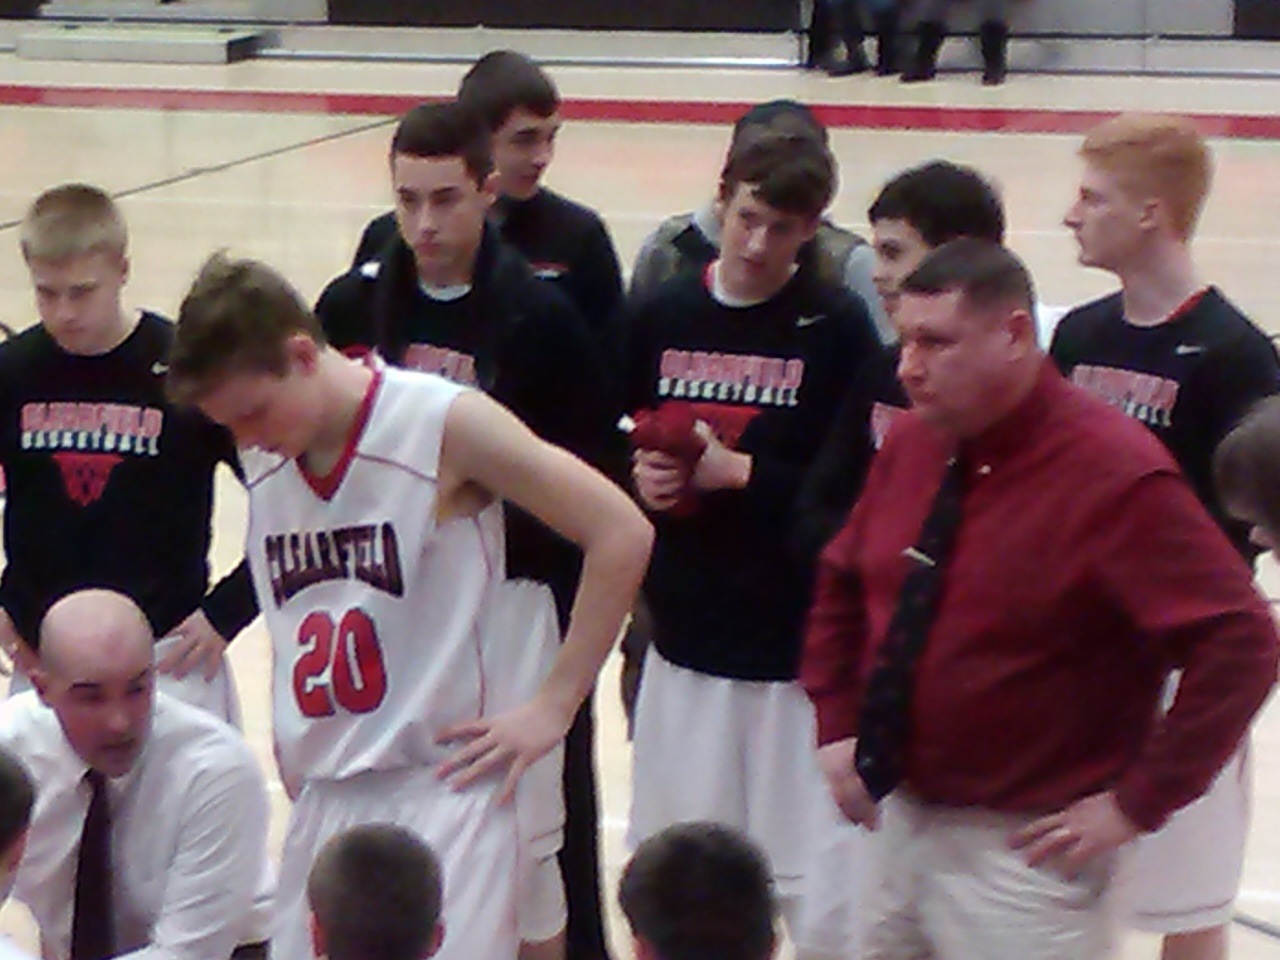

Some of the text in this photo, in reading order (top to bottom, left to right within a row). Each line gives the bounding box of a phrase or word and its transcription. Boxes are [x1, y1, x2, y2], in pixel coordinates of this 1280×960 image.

[658, 377, 798, 406] BASKETBALL
[22, 430, 159, 455] BASKETBALL
[266, 521, 404, 608] CLEARFIELD
[293, 607, 387, 717] 20
